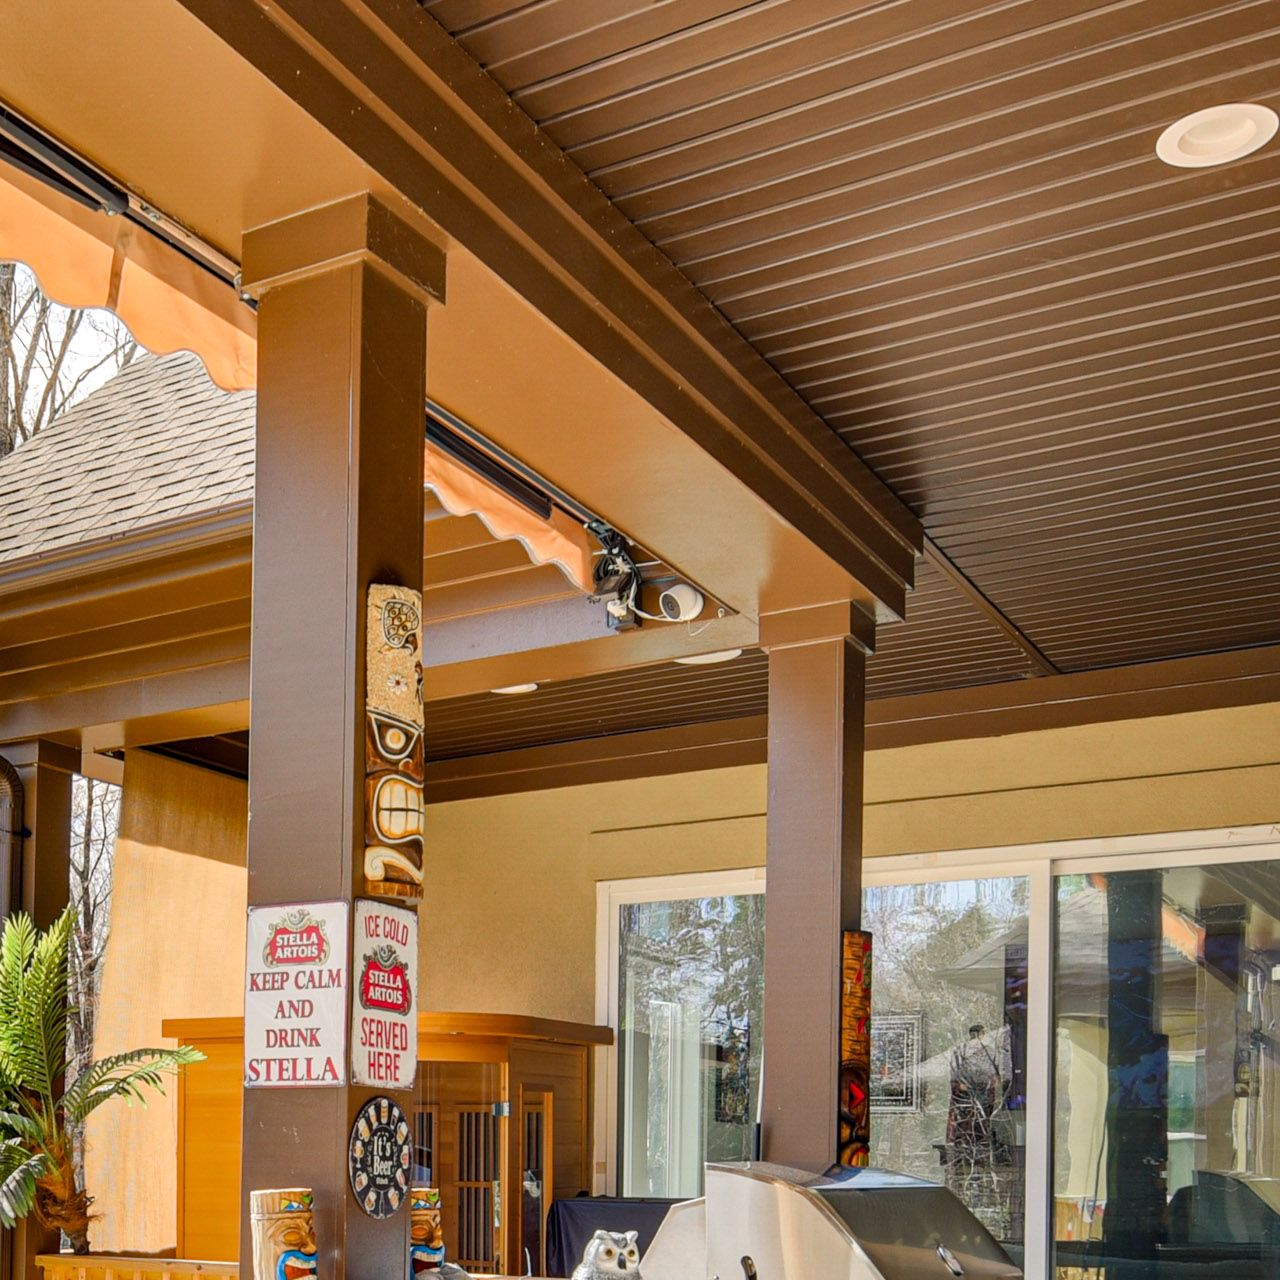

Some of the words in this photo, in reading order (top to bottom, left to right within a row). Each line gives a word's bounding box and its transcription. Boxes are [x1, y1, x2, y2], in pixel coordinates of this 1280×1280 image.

[276, 933, 319, 946] STELLA
[364, 914, 380, 939] ICE
[383, 916, 409, 946] COLD
[275, 945, 319, 958] ARTOIS
[249, 971, 289, 992] KEEP
[294, 968, 342, 989] CALM
[369, 970, 403, 987] STELLA
[369, 984, 403, 1005] ARTOIS
[275, 999, 314, 1019] AND
[265, 1028, 321, 1048] DRINK
[360, 1017, 408, 1051] SERVED
[249, 1056, 339, 1082] STELLA
[367, 1050, 400, 1082] HERE
[373, 1135, 391, 1157] It's
[373, 1155, 393, 1175] Beer
